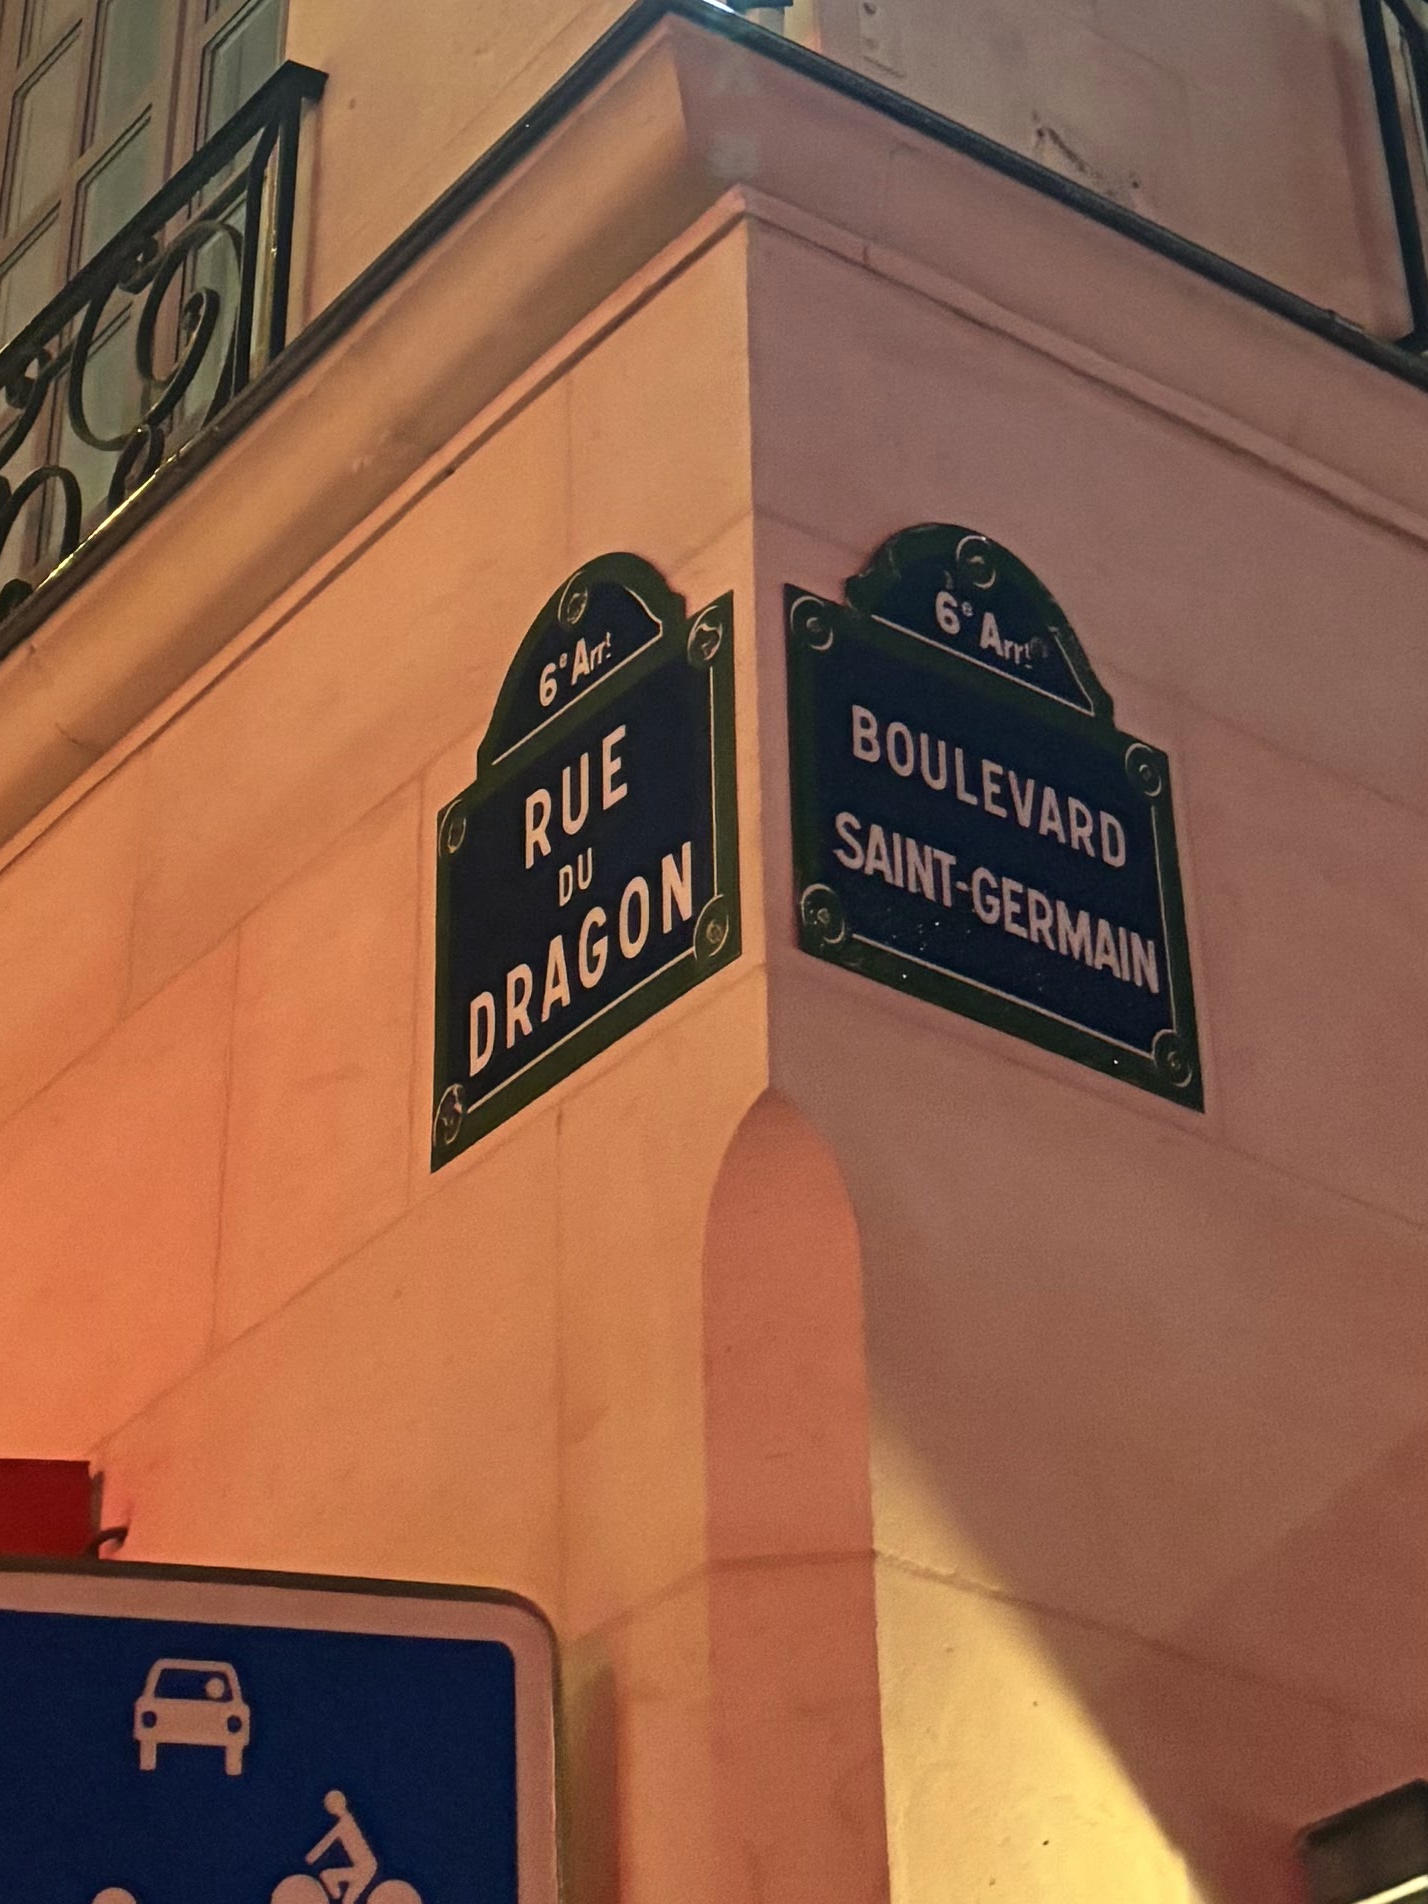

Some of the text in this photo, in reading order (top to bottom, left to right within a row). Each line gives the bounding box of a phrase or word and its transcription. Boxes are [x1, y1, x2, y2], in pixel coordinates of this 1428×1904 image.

[523, 724, 629, 870] RUE
[851, 704, 1128, 869] BOULEVARD
[468, 841, 694, 1078] DRAGON
[558, 847, 594, 908] DU
[833, 812, 1161, 994] SAINT-GERMAIN
